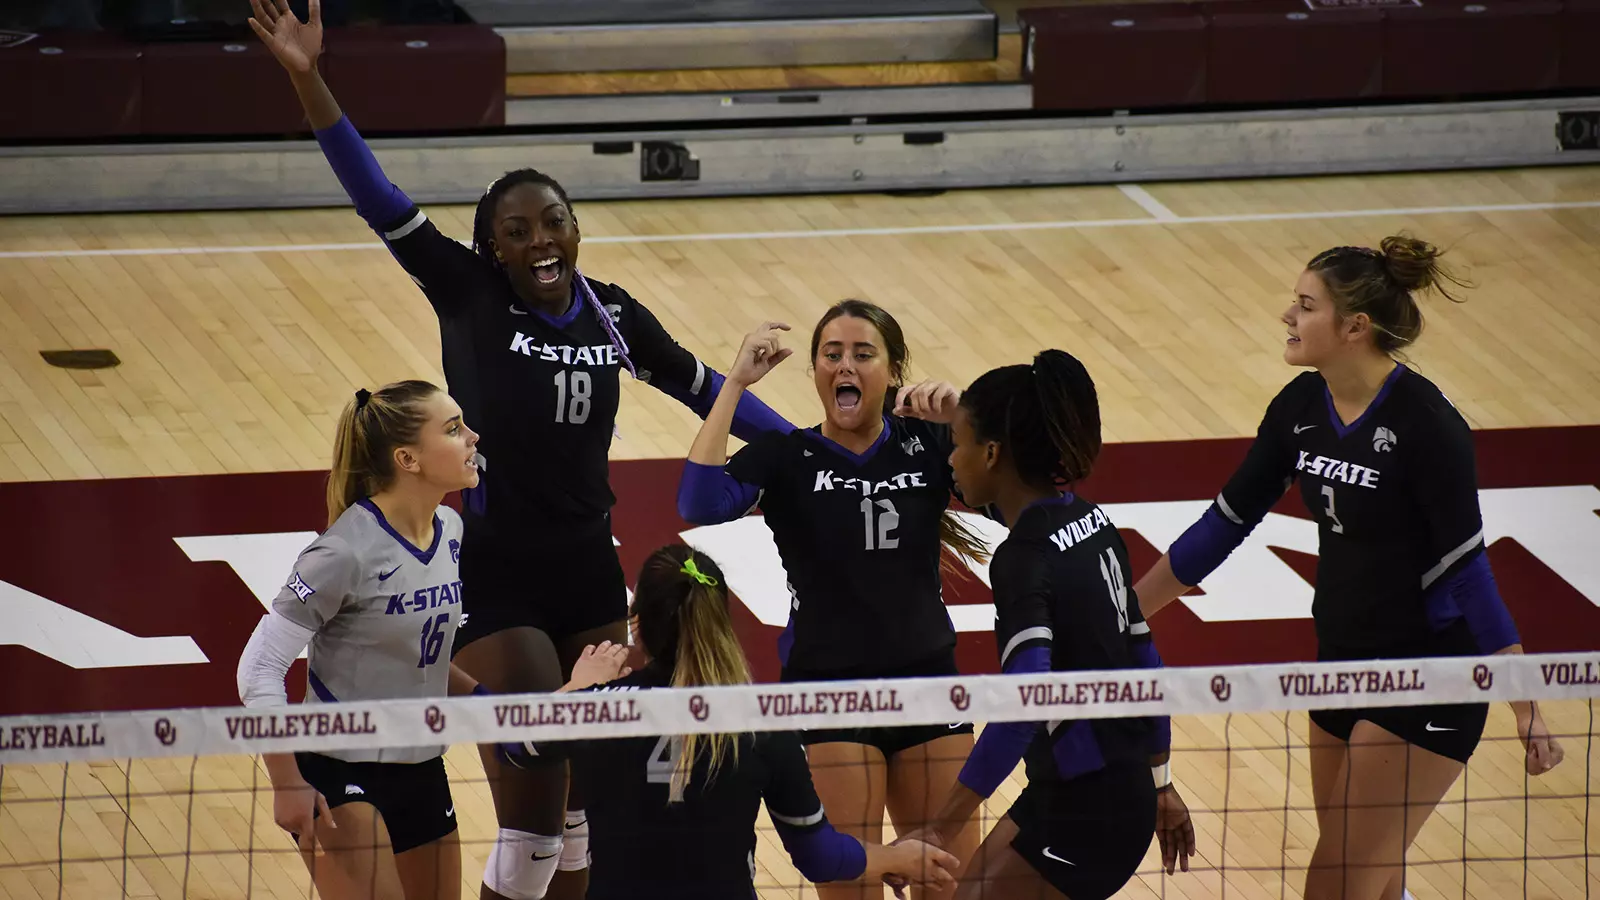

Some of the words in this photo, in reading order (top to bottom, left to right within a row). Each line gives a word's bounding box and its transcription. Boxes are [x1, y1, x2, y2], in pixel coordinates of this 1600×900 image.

[509, 331, 619, 366] K-STATE
[554, 369, 592, 424] 18
[813, 470, 927, 496] K-STATE
[1295, 450, 1380, 489] K-STATE
[860, 497, 900, 550] 12
[1049, 507, 1109, 552] WILDCA
[1321, 485, 1343, 534] 3
[385, 580, 463, 615] K-STAT
[1099, 546, 1129, 633] 14
[417, 613, 449, 668] 16
[225, 711, 377, 740] VOLLEYBALL
[494, 699, 642, 727] VOLLEYBALL
[757, 689, 903, 717] VOLLEYBALL
[1018, 679, 1164, 707] VOLLEYBALL
[1279, 669, 1425, 697] VOLLEYBALL
[1540, 661, 1600, 686] VOLL
[646, 734, 691, 802] 4
